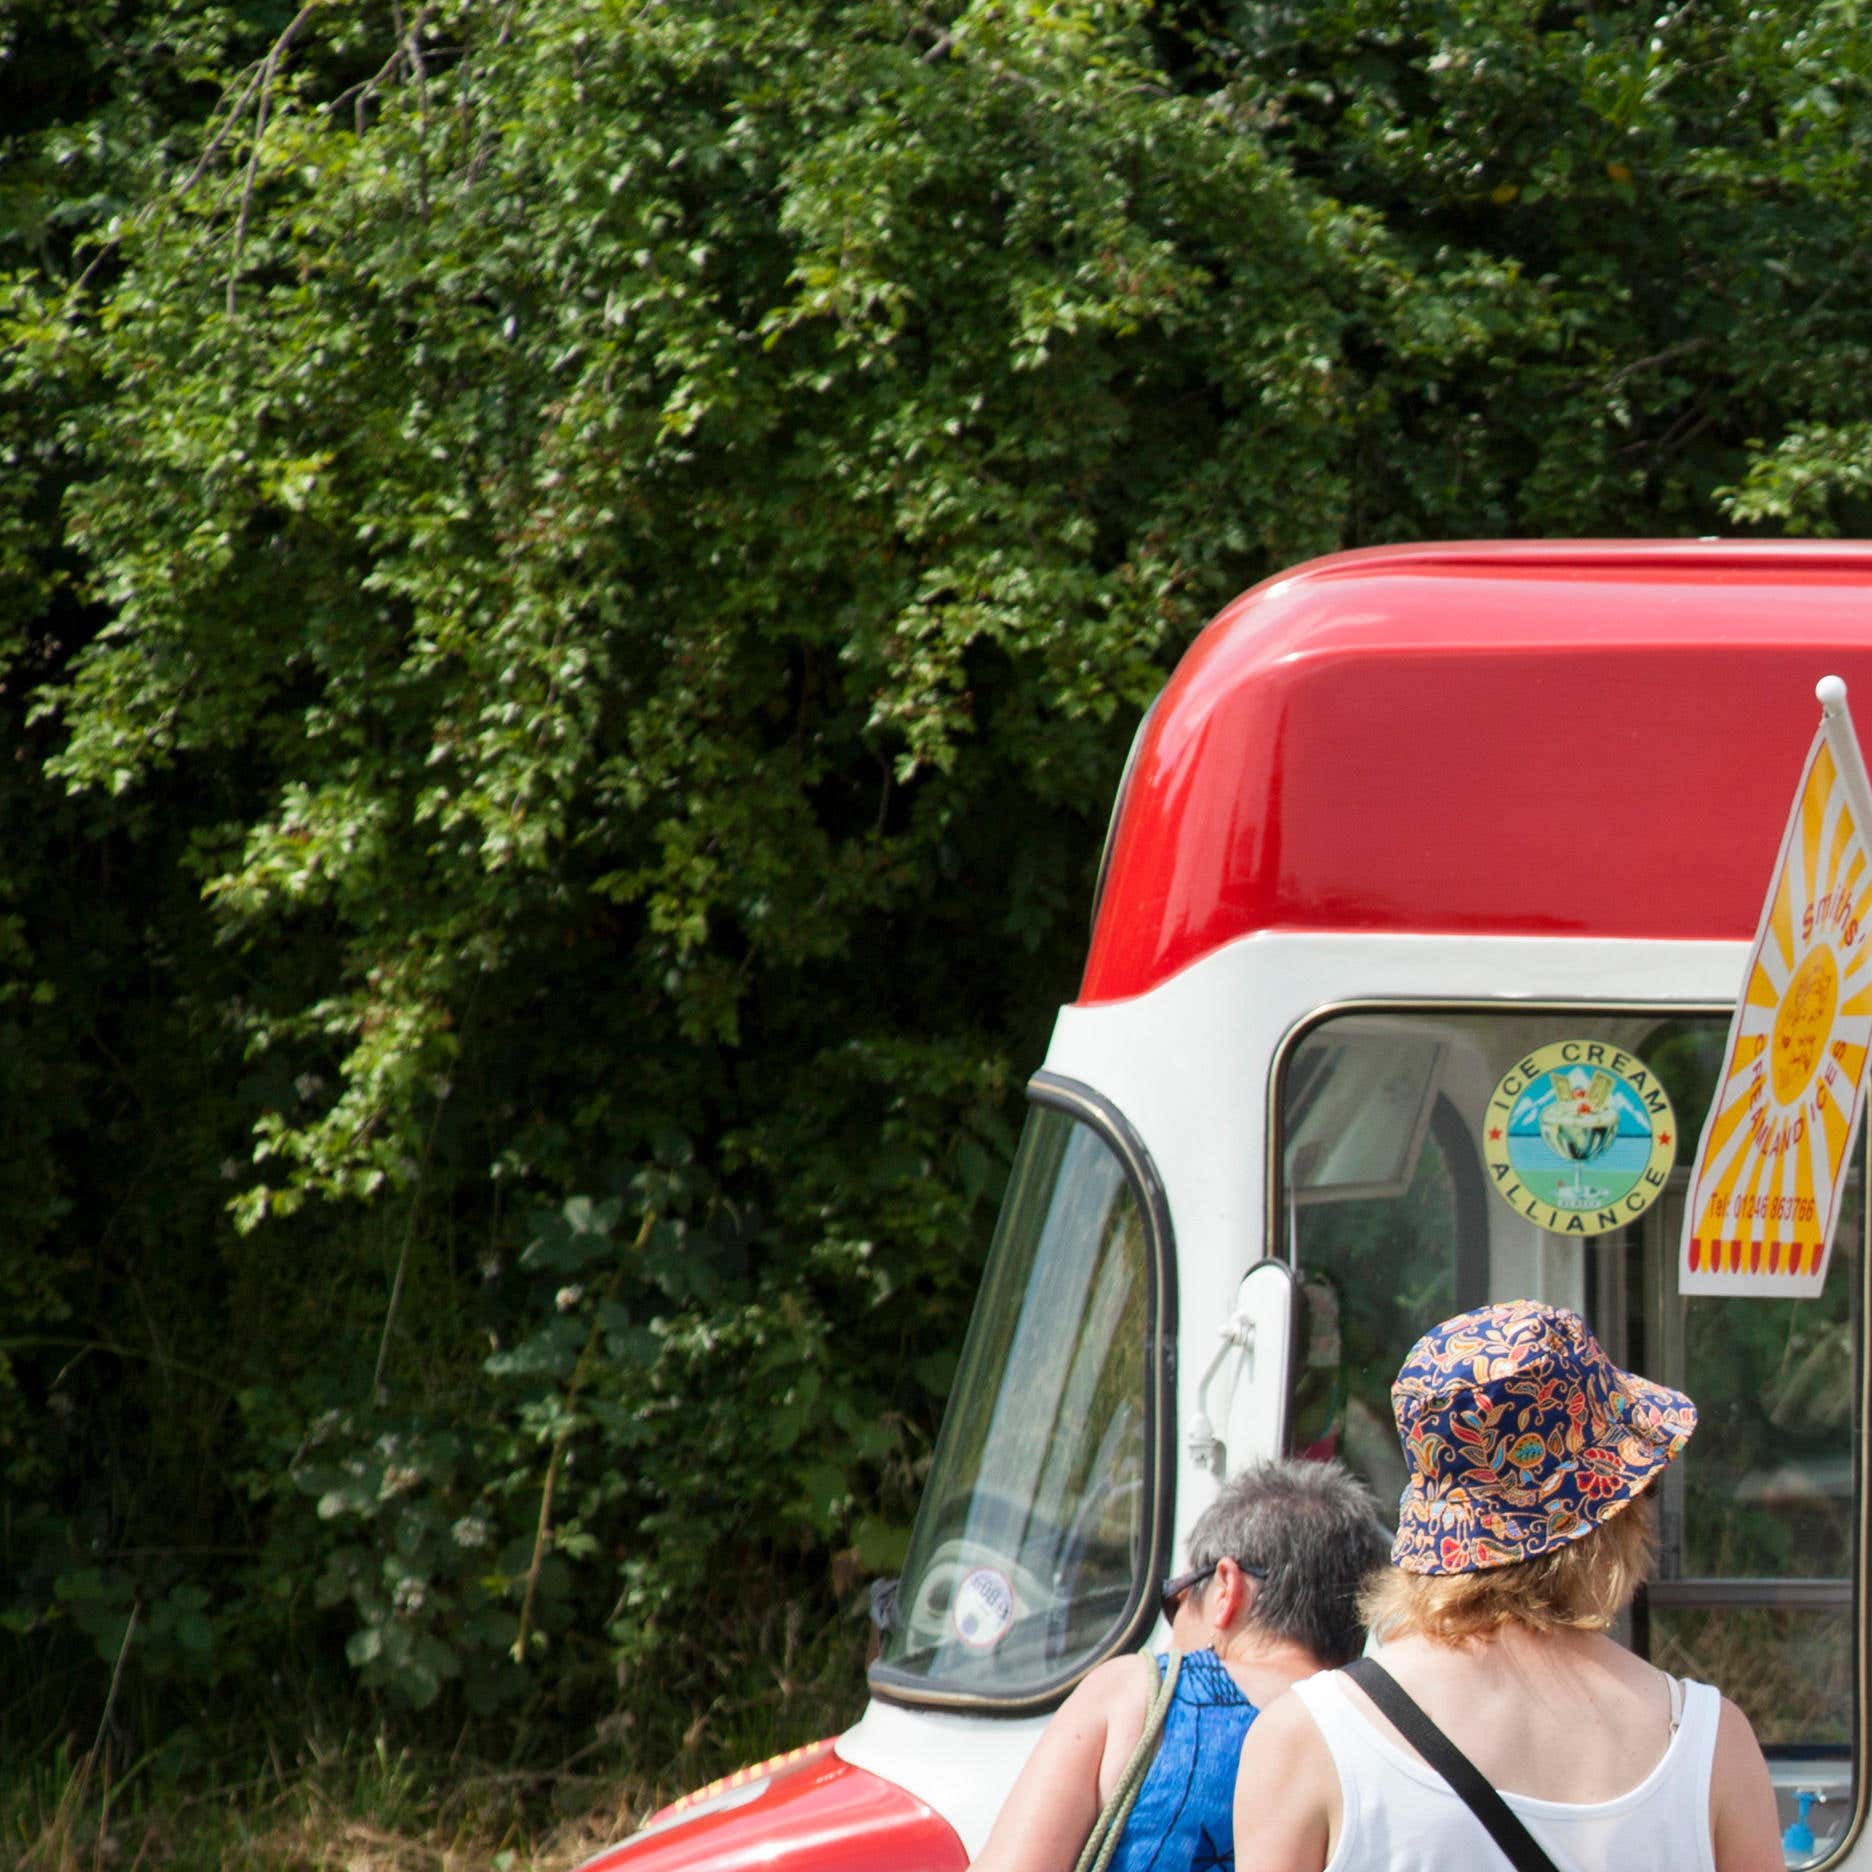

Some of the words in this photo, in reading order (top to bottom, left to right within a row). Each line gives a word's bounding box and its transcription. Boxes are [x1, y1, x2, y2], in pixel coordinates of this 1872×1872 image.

[1494, 1057, 1541, 1110] ICE
[1561, 1043, 1667, 1114] CREAM
[1491, 1162, 1665, 1232] ALLIANCE
[1734, 1194, 1767, 1219] 01246
